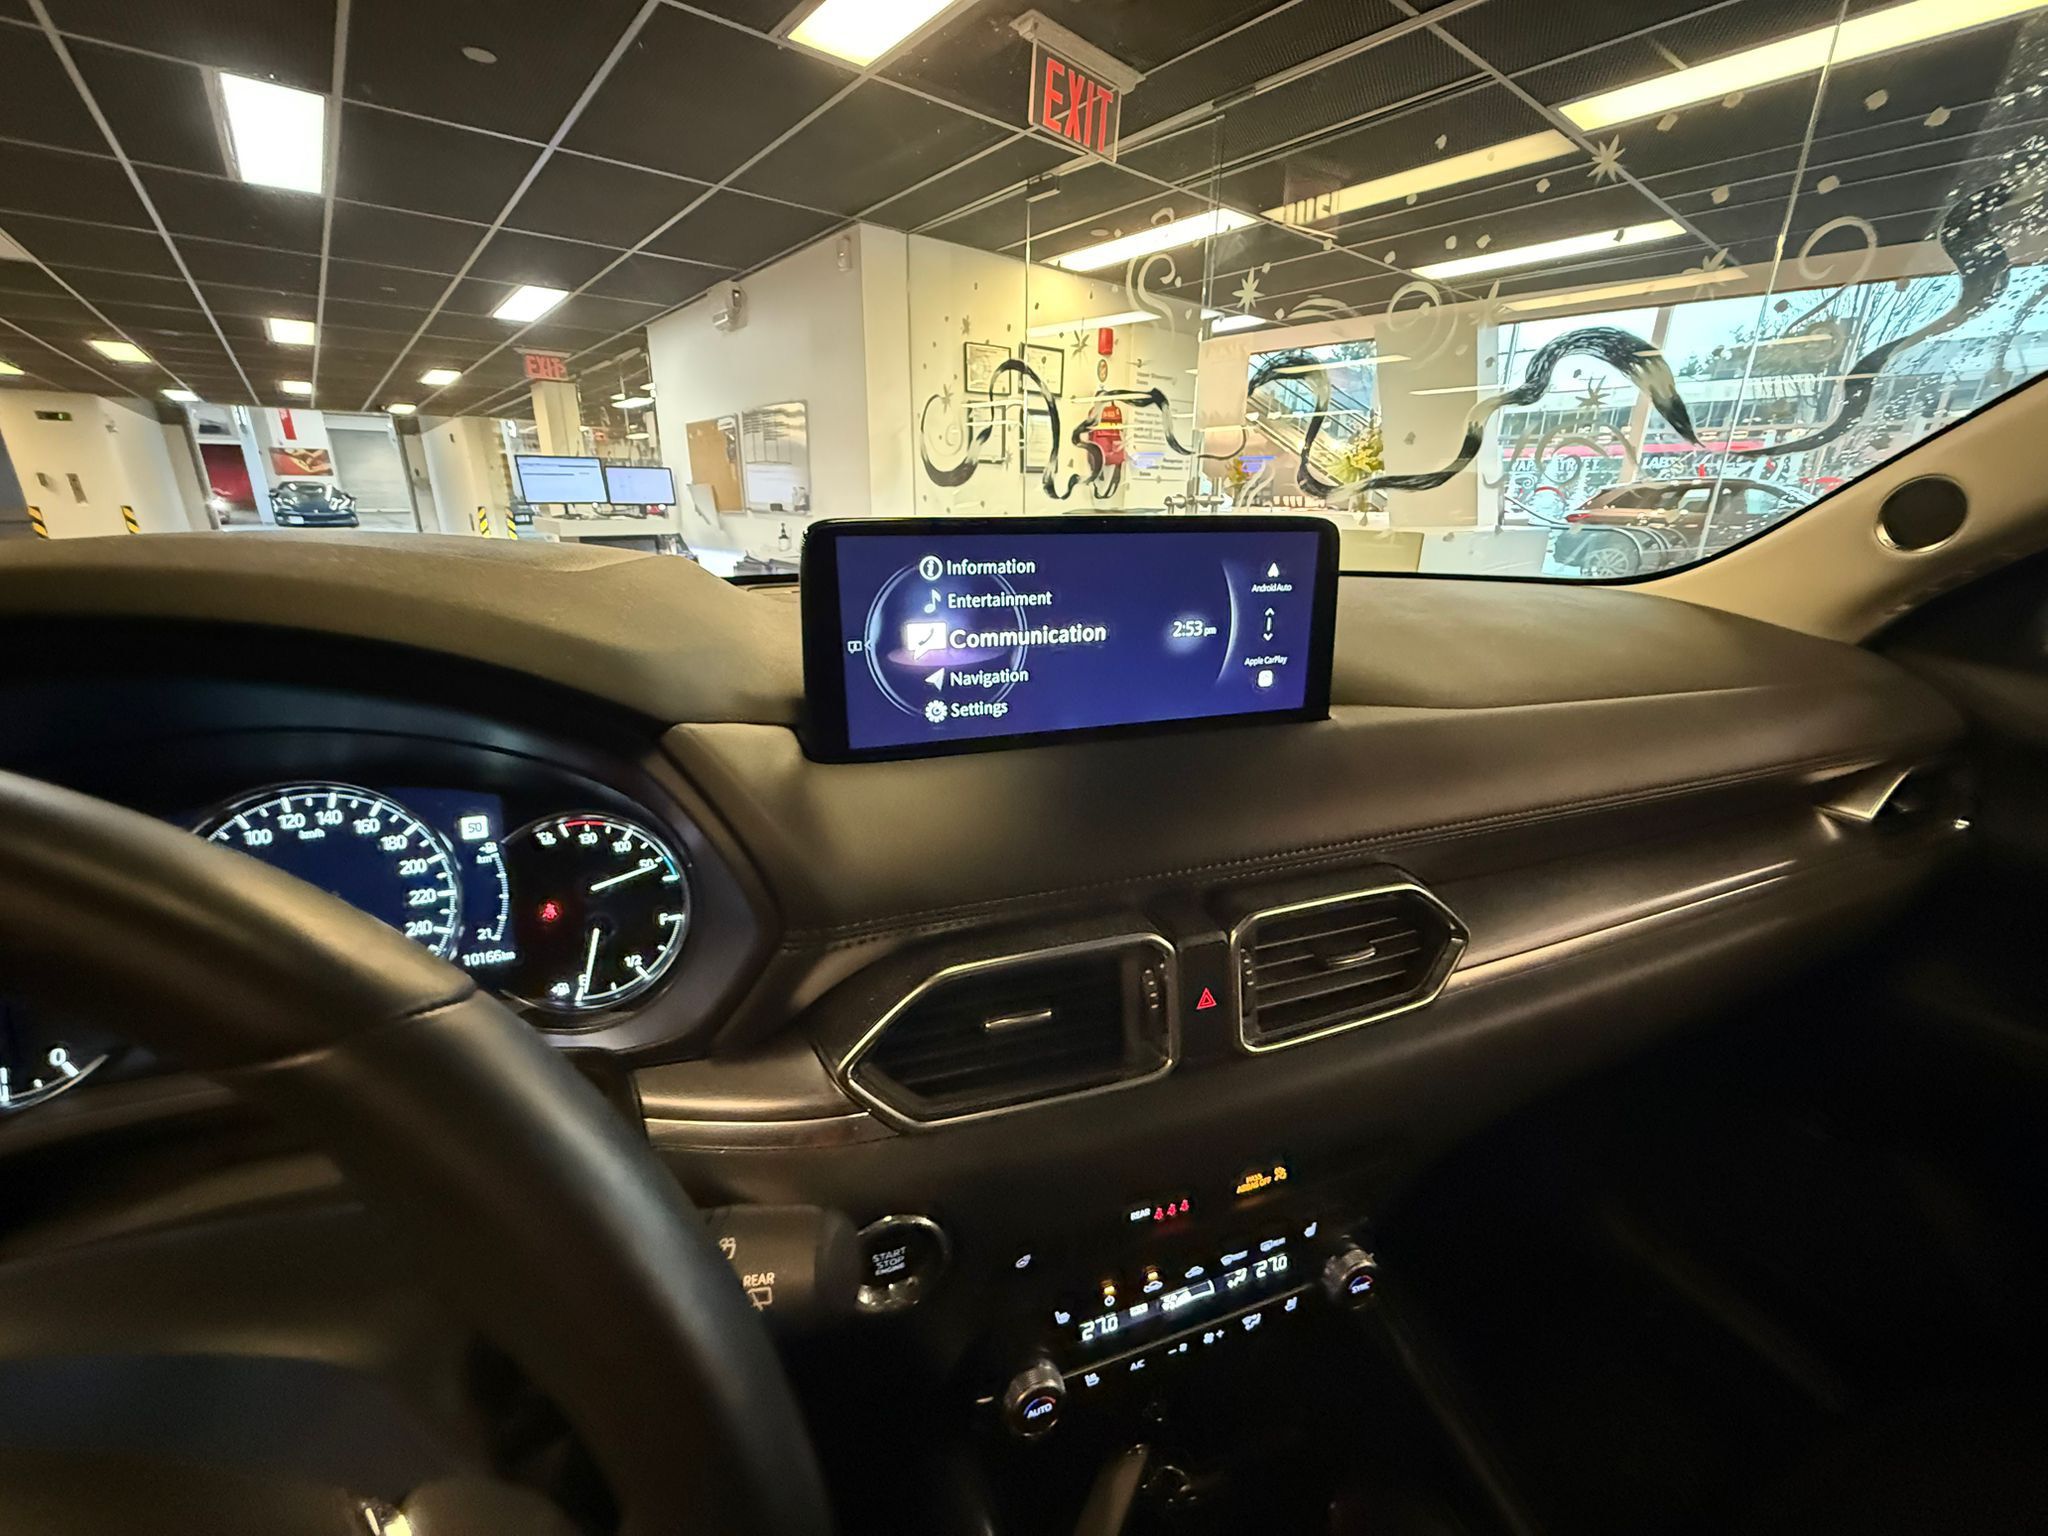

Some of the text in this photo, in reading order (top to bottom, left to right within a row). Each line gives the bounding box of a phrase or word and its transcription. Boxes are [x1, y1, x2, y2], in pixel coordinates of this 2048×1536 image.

[1042, 56, 1113, 154] EXIT
[527, 355, 562, 378] EXIT
[946, 558, 1036, 576] Information
[1251, 583, 1293, 593] Android Auto
[947, 590, 1052, 609] Entertainment
[949, 623, 1107, 650] Communication
[1172, 620, 1217, 637] 2:53 pm
[1244, 655, 1288, 667] Apple CarPlay
[950, 667, 1029, 687] Navigation
[951, 699, 1008, 719] Settings
[277, 813, 306, 830] 120
[315, 809, 343, 825] 140
[298, 828, 326, 841] km/h
[353, 817, 381, 835] 160
[468, 823, 482, 833] 50
[243, 828, 273, 846] 100
[380, 835, 408, 852] 180
[612, 840, 632, 853] 100
[399, 858, 428, 876] 200
[408, 888, 437, 906] 220
[405, 920, 434, 937] 240
[624, 954, 643, 968] 1/2
[49, 1047, 67, 1066] 0
[1130, 1207, 1151, 1221] REAR
[872, 1246, 907, 1263] START
[876, 1255, 905, 1269] STOP
[743, 1272, 775, 1288] REAR
[1130, 1359, 1146, 1371] A/C
[1027, 1402, 1053, 1419] AUTO
